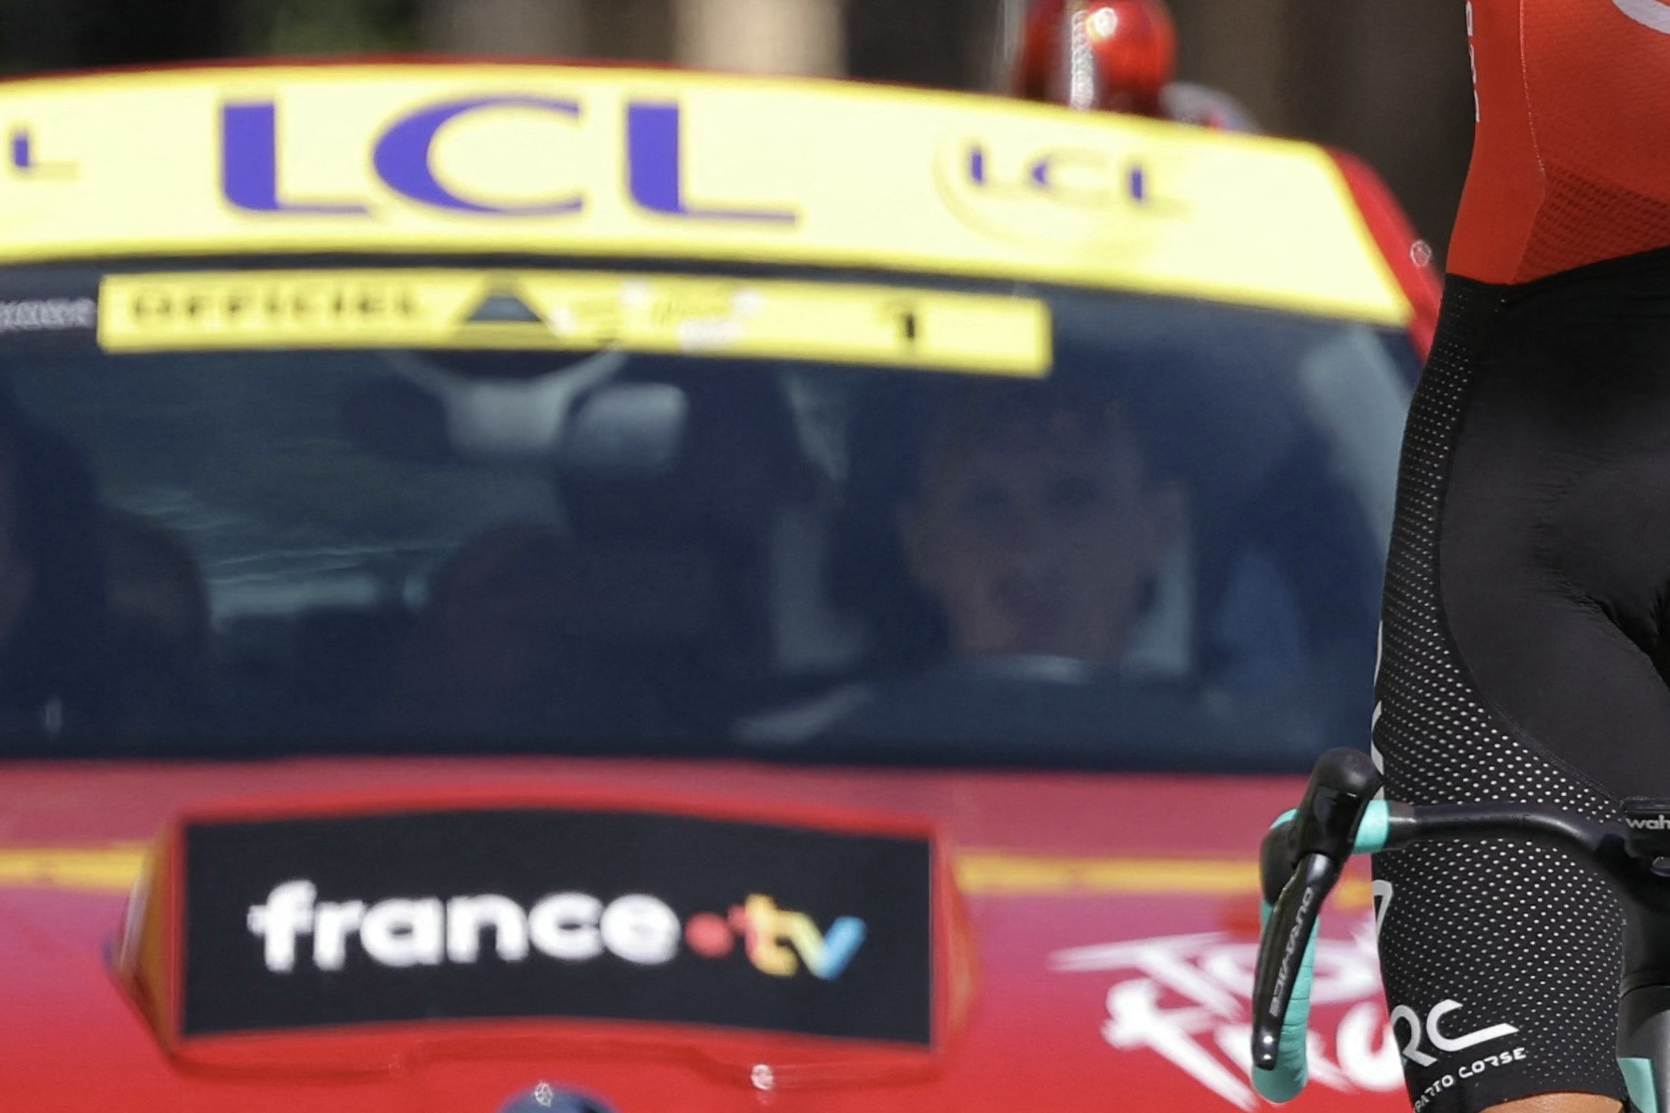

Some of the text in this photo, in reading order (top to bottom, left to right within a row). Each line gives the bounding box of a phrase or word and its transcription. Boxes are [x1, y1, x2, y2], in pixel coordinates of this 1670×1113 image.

[219, 91, 797, 223] LCL
[1413, 1047, 1527, 1113] PARTO CORSE
